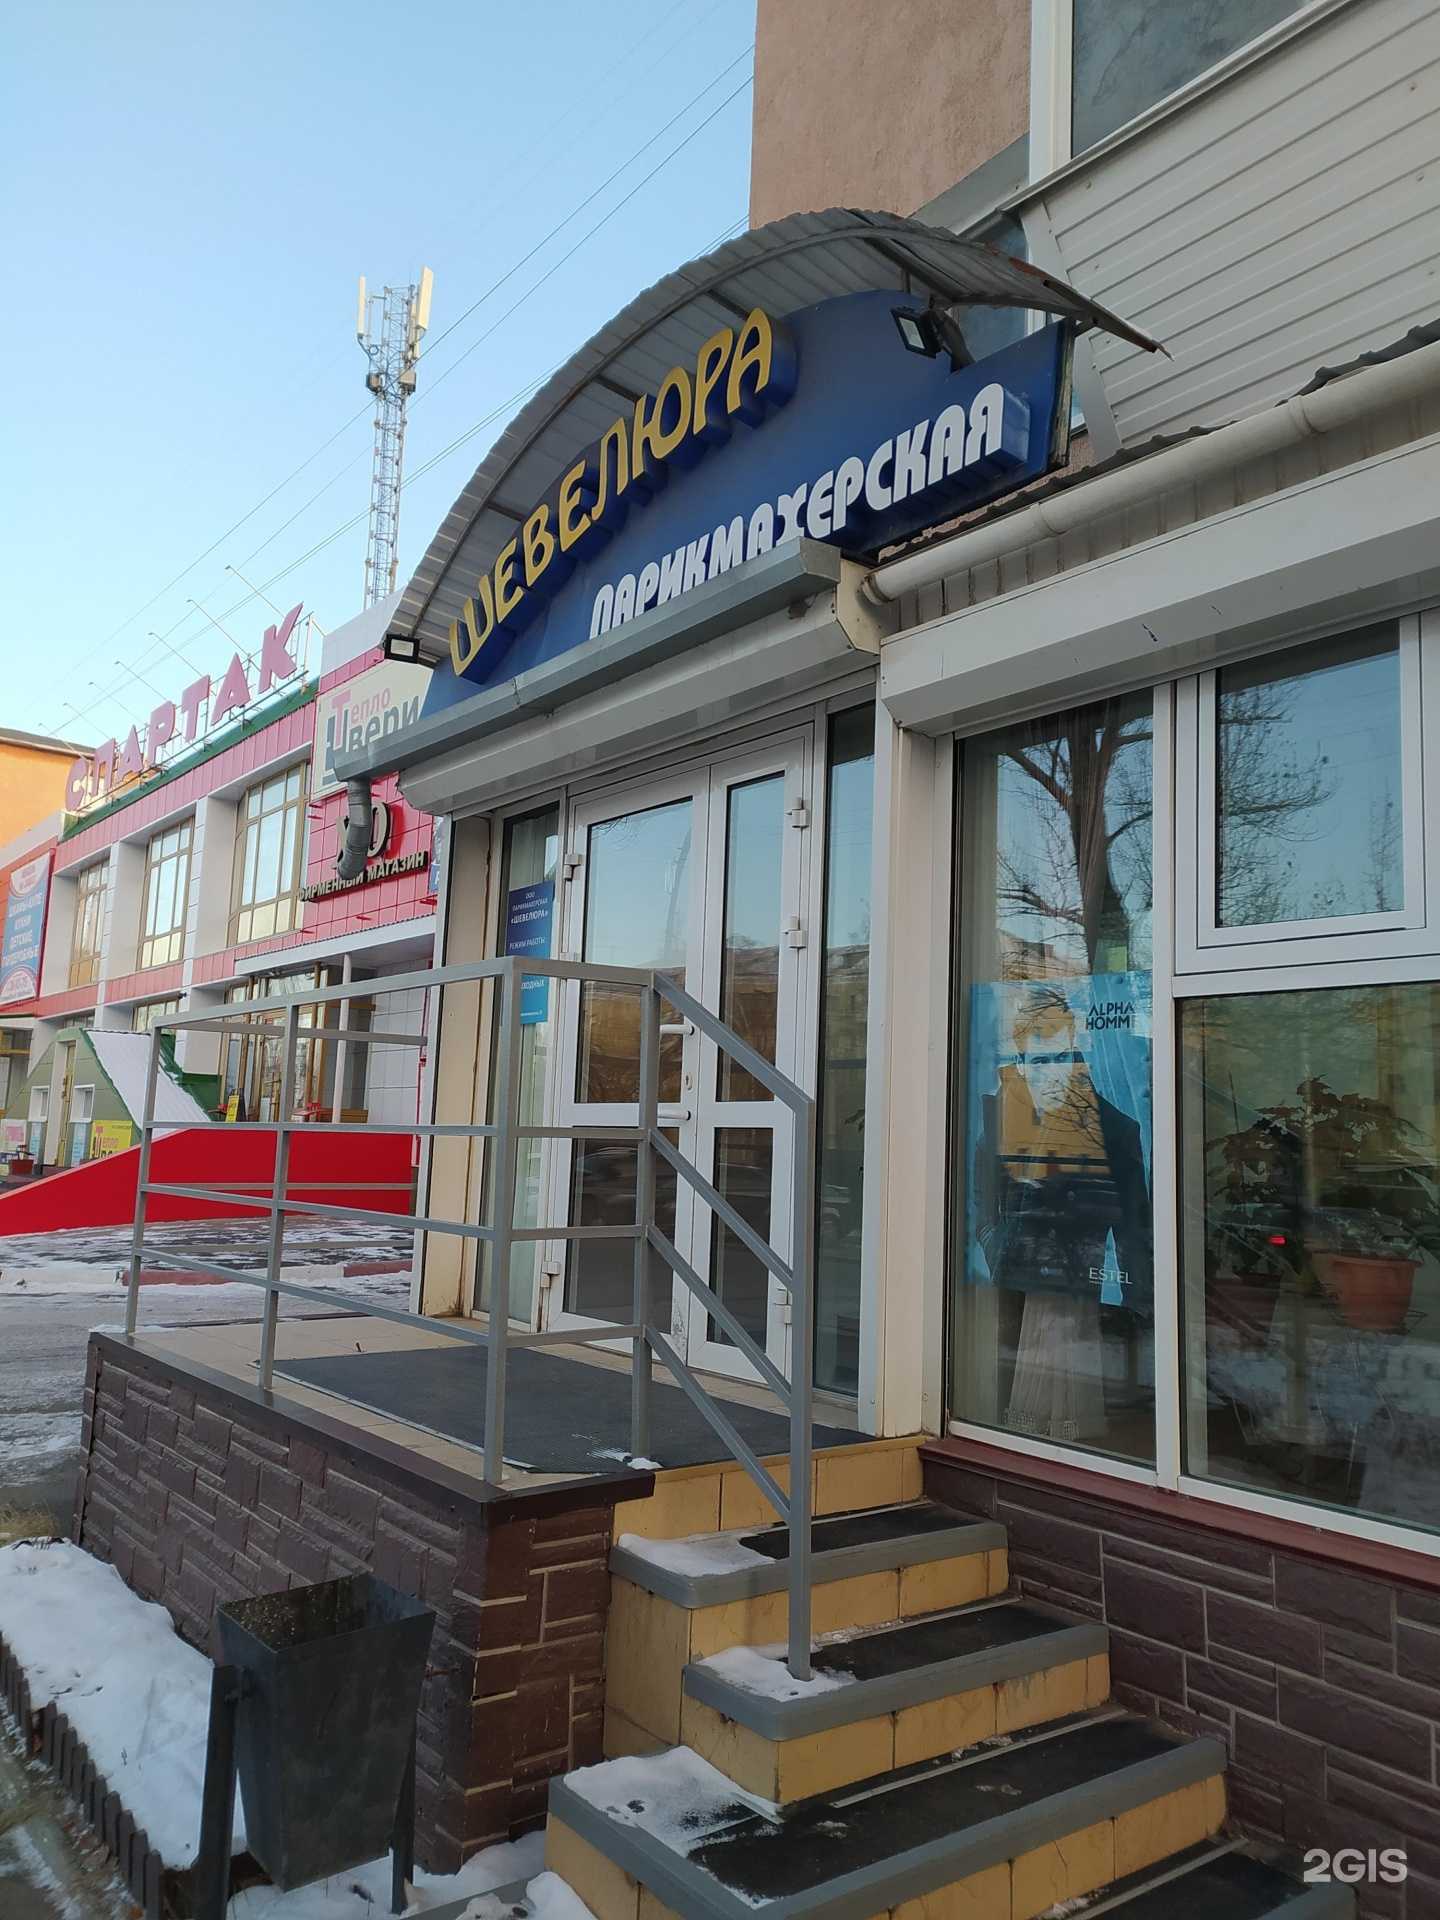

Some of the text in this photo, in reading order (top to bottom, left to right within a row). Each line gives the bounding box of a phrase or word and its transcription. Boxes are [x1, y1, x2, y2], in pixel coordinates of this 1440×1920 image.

[450, 308, 772, 676] ШЕВЕЛЮРА
[590, 383, 1004, 640] ПАРИКМАХЕРСКАЯ
[65, 602, 303, 811] СПАРТАК
[332, 688, 391, 750] Тепло
[366, 851, 425, 883] МАГАЗИН
[1089, 1002, 1136, 1016] ALPHA
[1089, 1267, 1133, 1284] ESTEL
